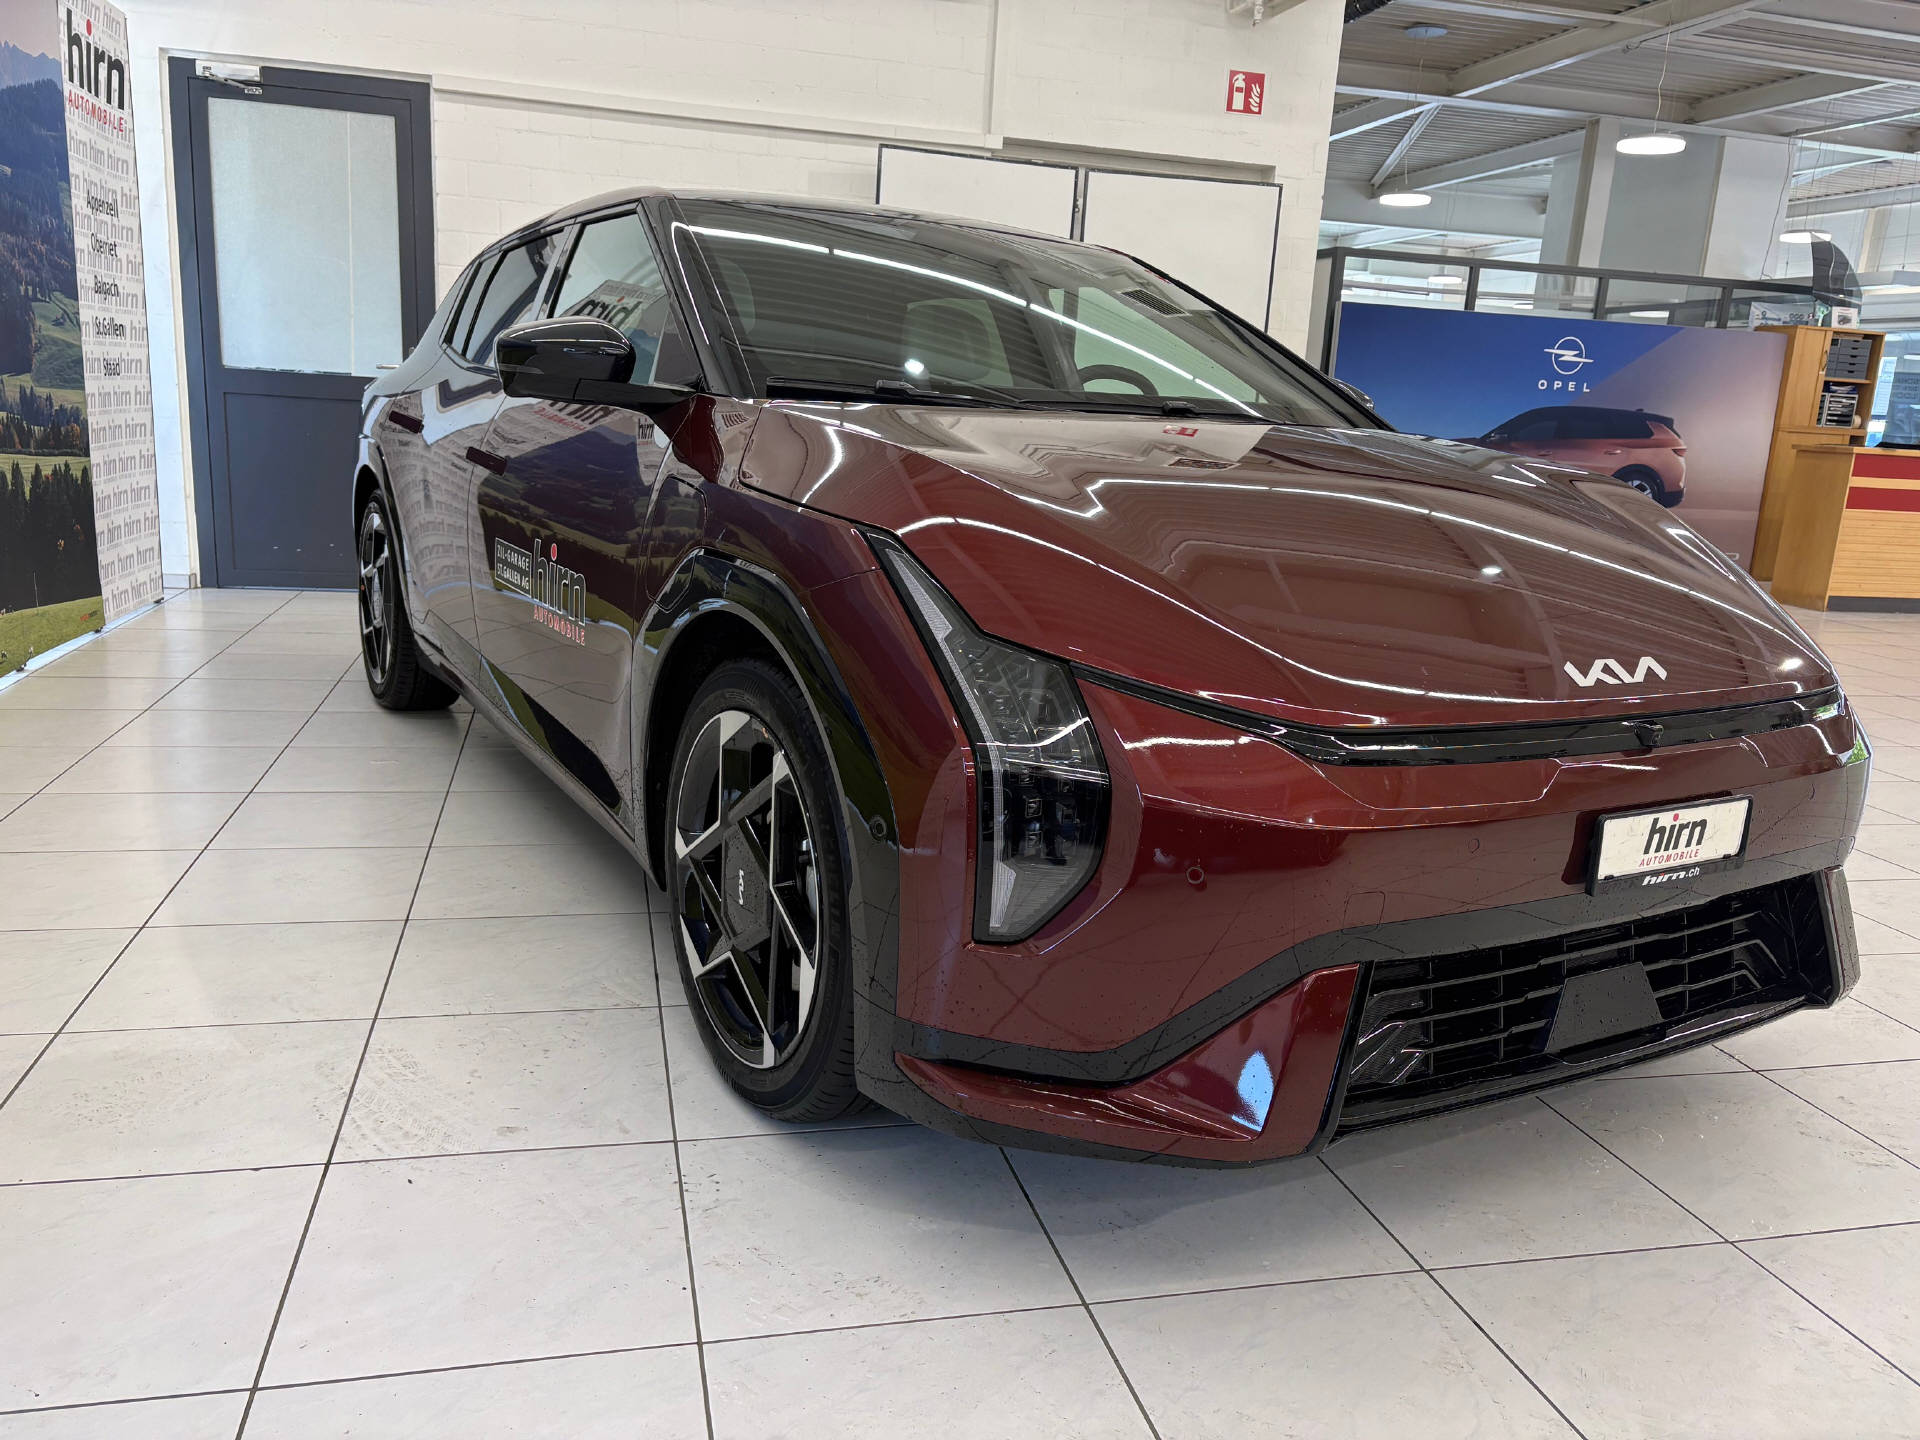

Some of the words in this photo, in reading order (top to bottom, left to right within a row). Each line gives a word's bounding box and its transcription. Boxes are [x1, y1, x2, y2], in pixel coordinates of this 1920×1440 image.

[66, 7, 125, 111] hirn
[68, 89, 124, 133] AUTOMOBILE
[86, 189, 119, 218] Appenzell
[93, 274, 119, 301] Balgach
[103, 356, 121, 377] Staad
[1537, 379, 1591, 398] OPEL
[497, 544, 530, 571] ZIL-GARAGE
[497, 563, 521, 586] ST.GALLEN
[521, 574, 530, 590] AG
[532, 538, 587, 627] hirn
[532, 604, 586, 647] AUTOMOBILE
[1643, 812, 1708, 855] hirn
[1638, 848, 1700, 868] AUTOMOBILE
[1641, 866, 1700, 886] hirn.ch
